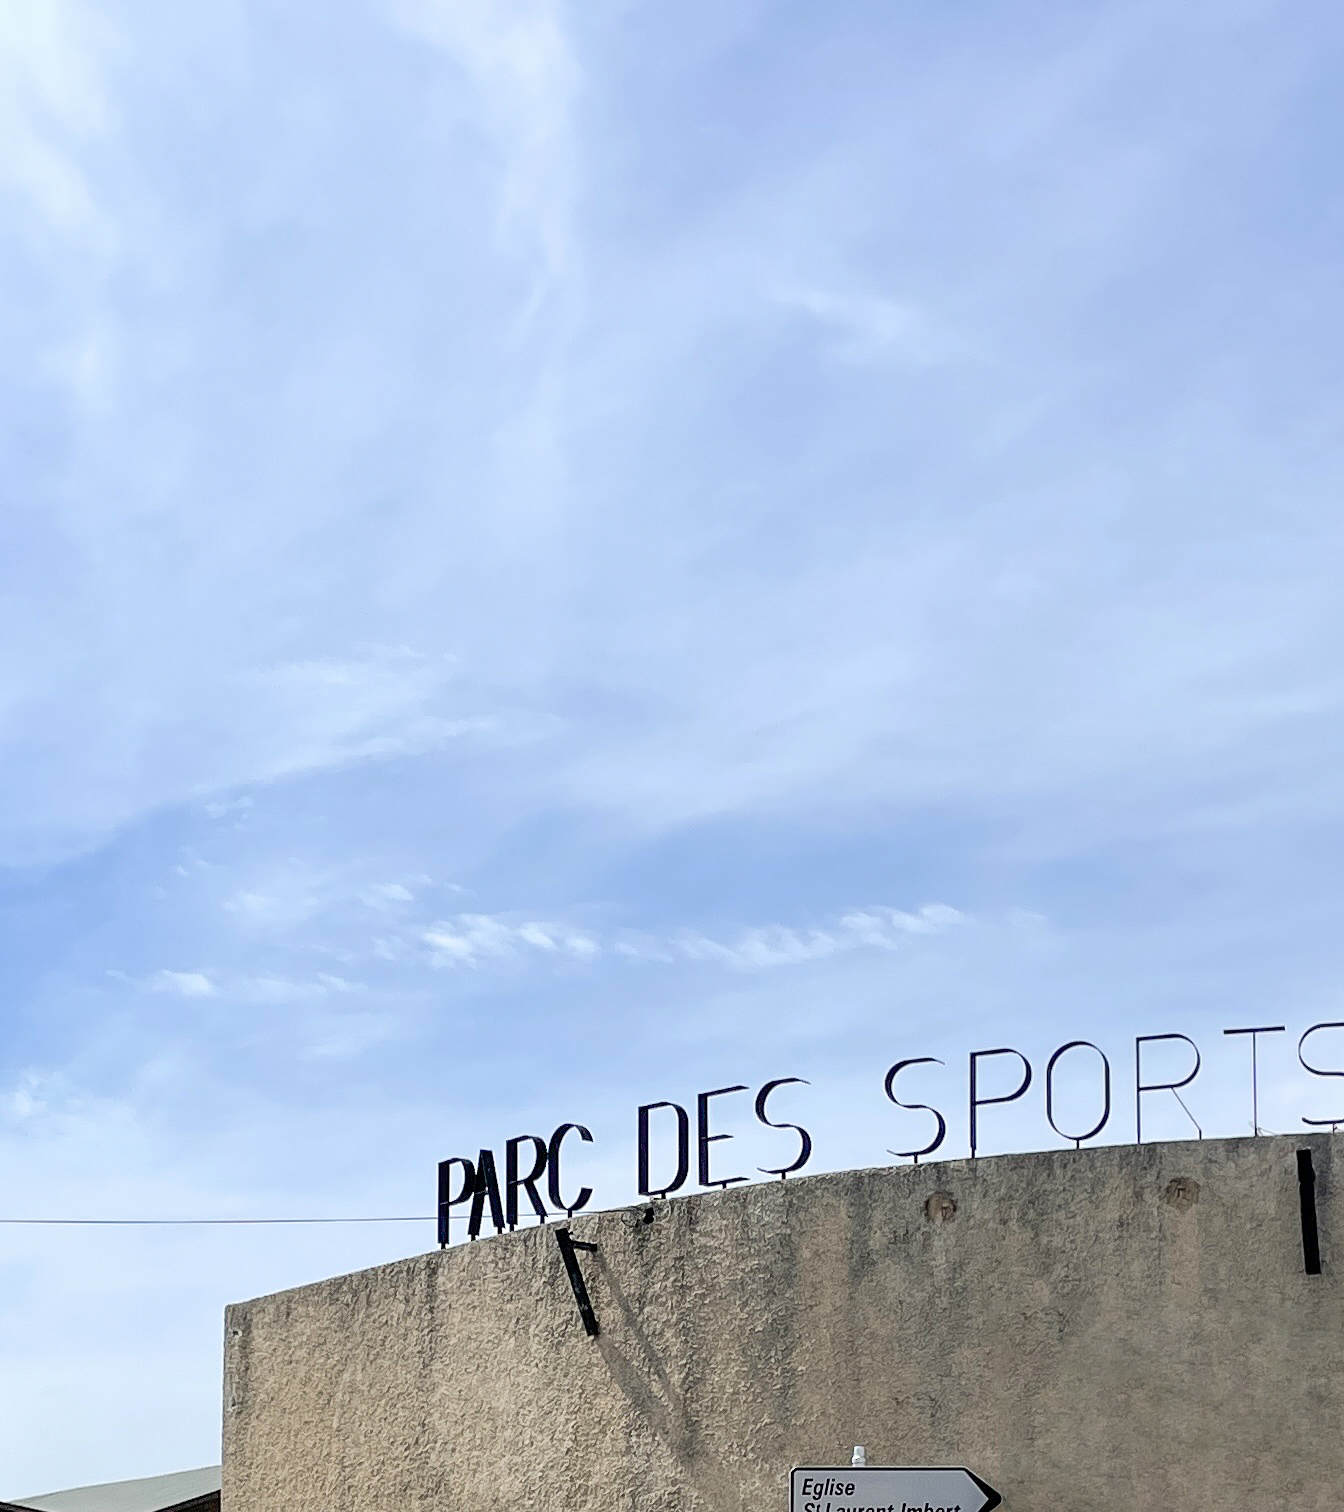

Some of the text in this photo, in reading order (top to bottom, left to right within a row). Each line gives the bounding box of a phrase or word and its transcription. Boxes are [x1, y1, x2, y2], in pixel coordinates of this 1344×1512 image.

[437, 1123, 594, 1247] PARC
[638, 1077, 812, 1197] DES
[802, 1478, 855, 1500] Eglise
